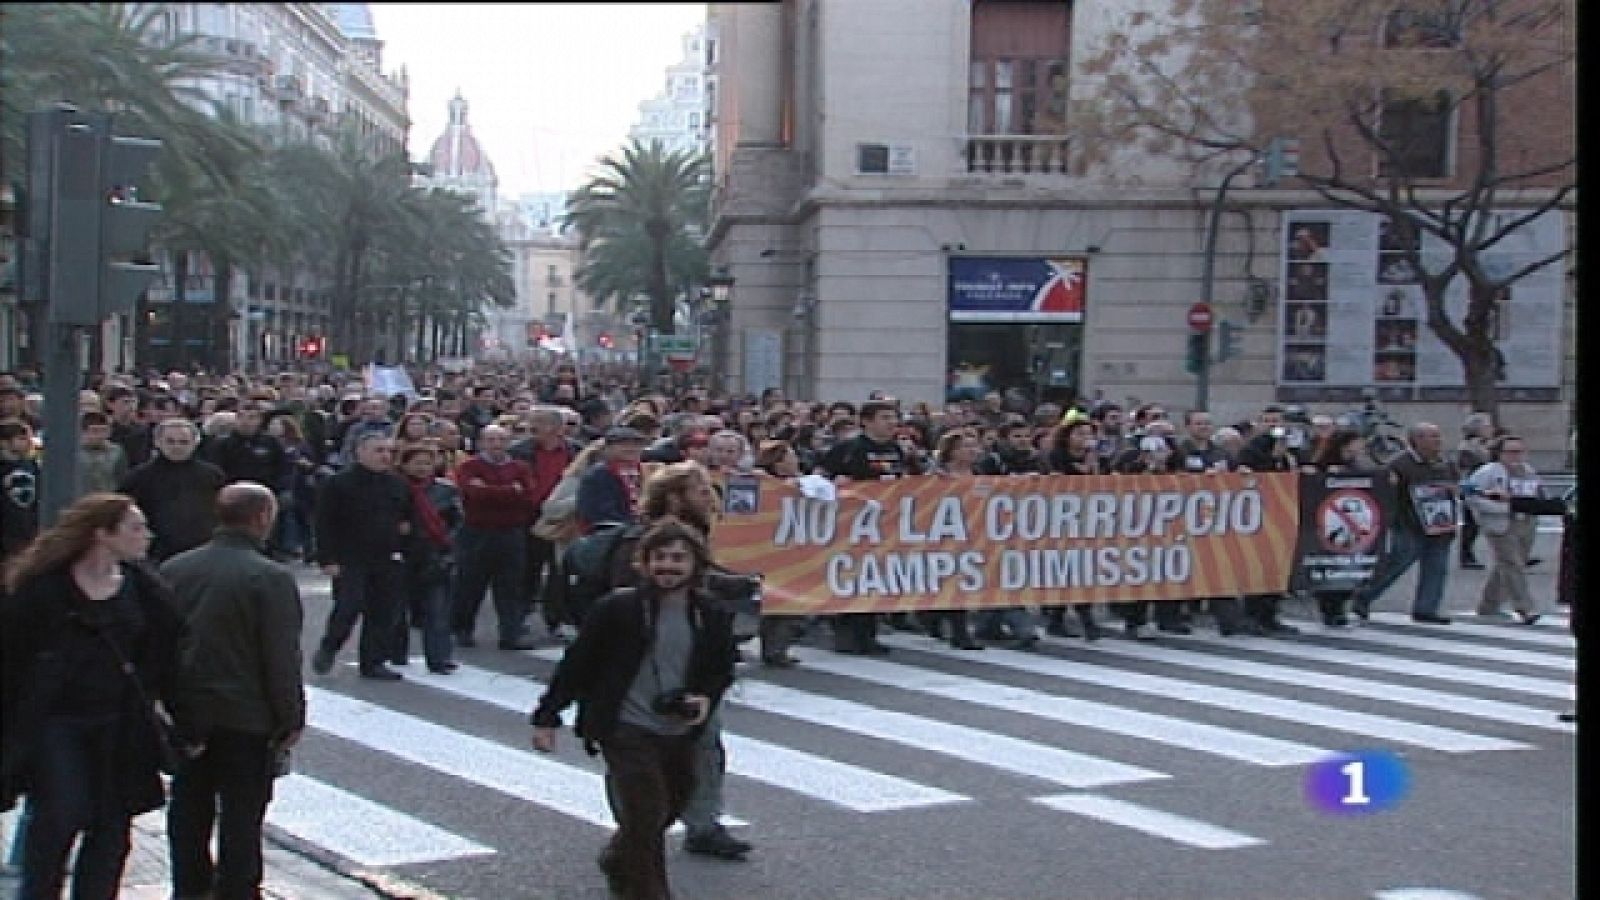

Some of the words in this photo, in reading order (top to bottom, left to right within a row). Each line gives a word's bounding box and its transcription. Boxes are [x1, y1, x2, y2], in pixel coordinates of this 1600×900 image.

[774, 496, 838, 546] NO
[851, 499, 882, 545] A
[899, 496, 968, 542] LA
[986, 478, 1262, 541] CORRUPCIÓ
[827, 551, 985, 597] CAMPS
[1001, 533, 1192, 590] DIMISSIÓ
